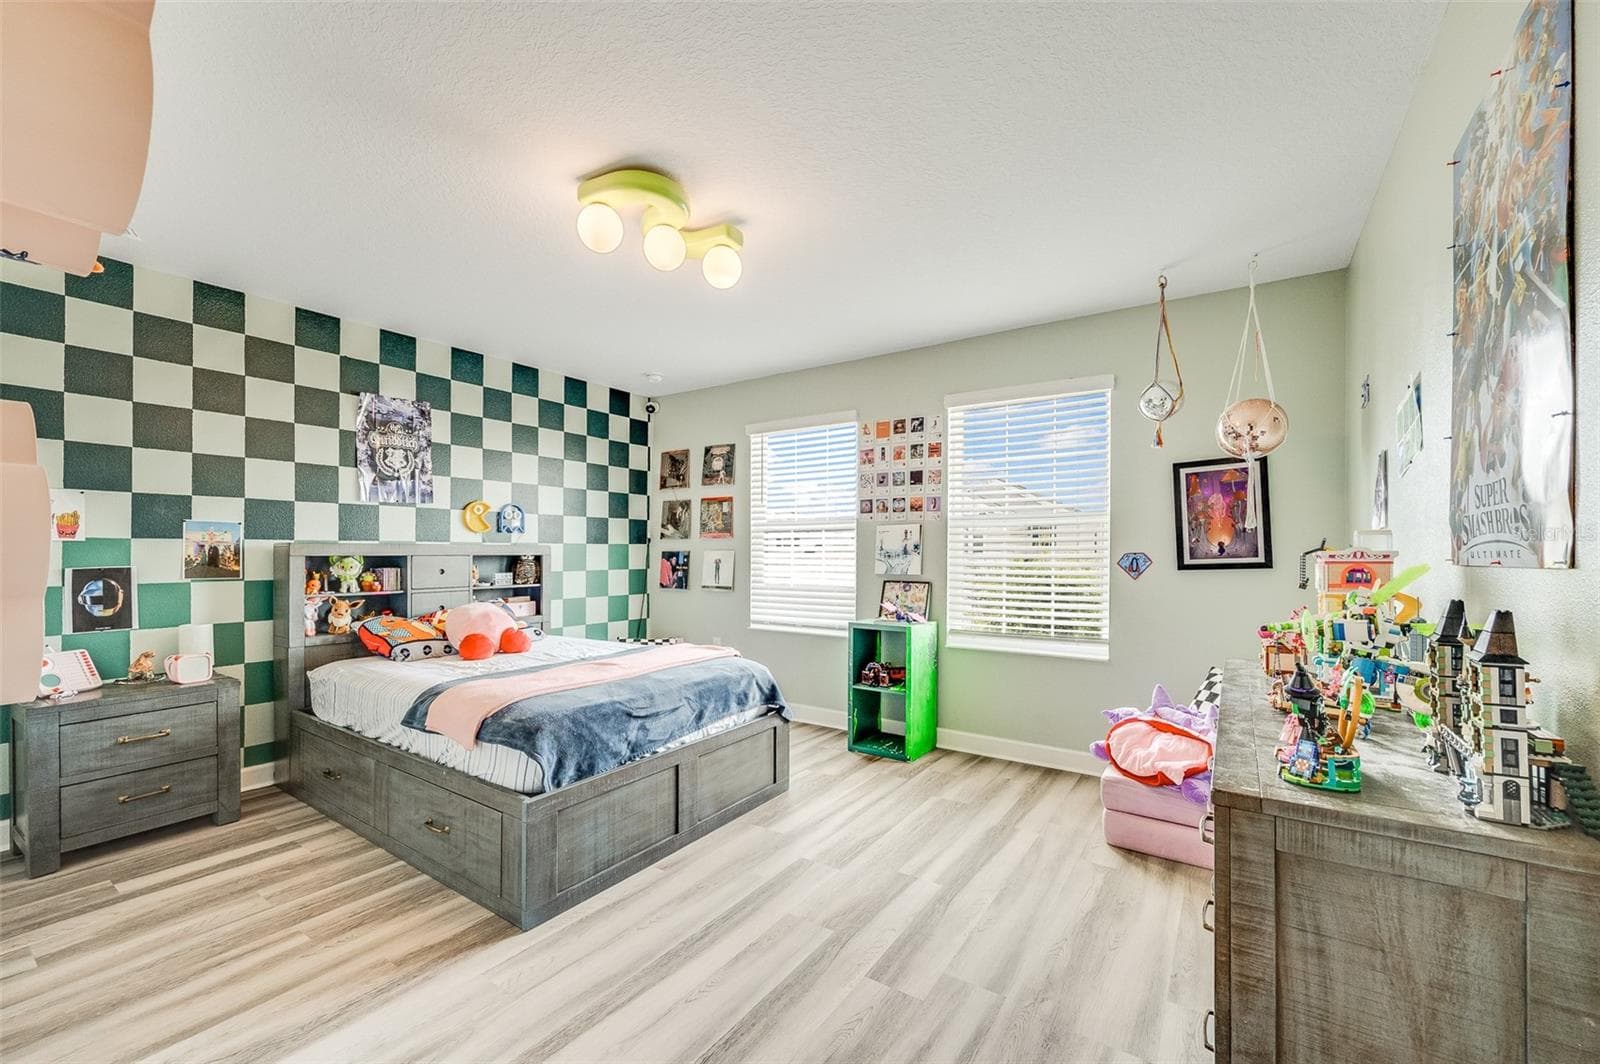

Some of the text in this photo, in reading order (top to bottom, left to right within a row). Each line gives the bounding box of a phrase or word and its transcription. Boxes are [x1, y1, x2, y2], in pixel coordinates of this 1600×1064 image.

[1474, 477, 1509, 509] SUPER
[1462, 510, 1494, 546] SMASH
[1470, 549, 1521, 559] ULTIMATE
